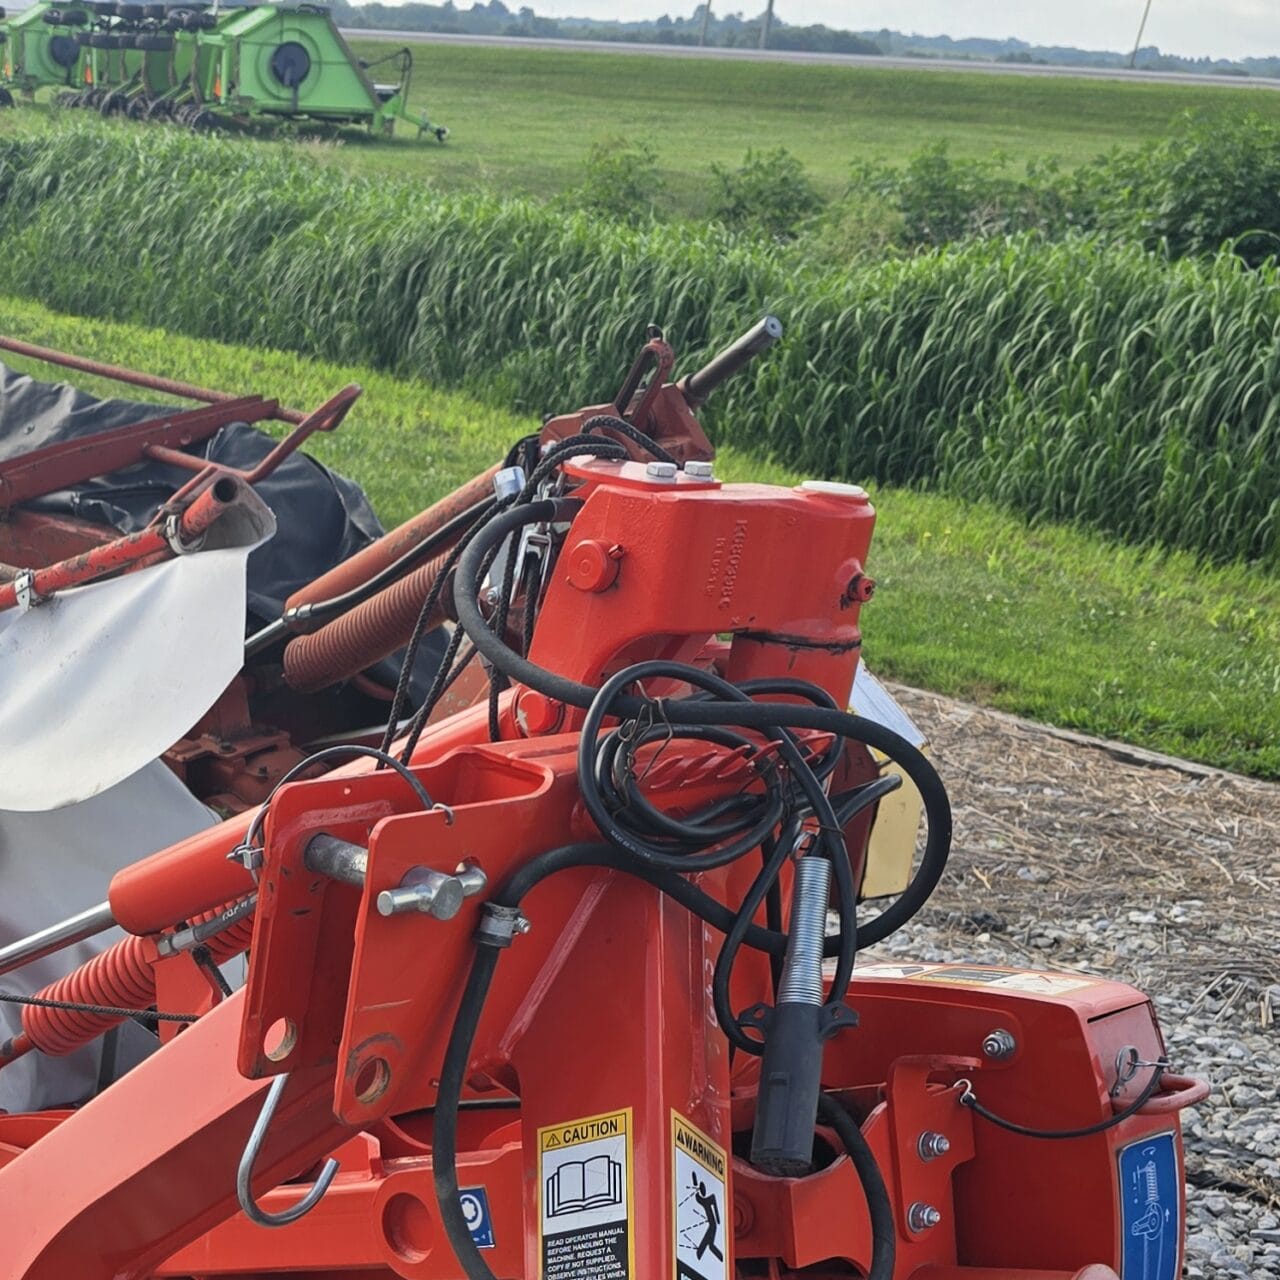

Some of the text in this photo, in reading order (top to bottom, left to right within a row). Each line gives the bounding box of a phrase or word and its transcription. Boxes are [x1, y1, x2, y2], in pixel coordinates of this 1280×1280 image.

[563, 1118, 618, 1144] CAUTION
[684, 1131, 724, 1175] WARNING
[547, 1227, 624, 1247] READ OPERATOR MANUAL
[547, 1245, 571, 1256] BEFORE
[573, 1239, 604, 1251] HANDLING
[577, 1248, 605, 1258] REQUEST
[547, 1262, 621, 1280] OBSERVE INSTRUCTIONS
[548, 1264, 564, 1272] COPY
[572, 1260, 584, 1268] NOT
[607, 1270, 626, 1279] WHEN
